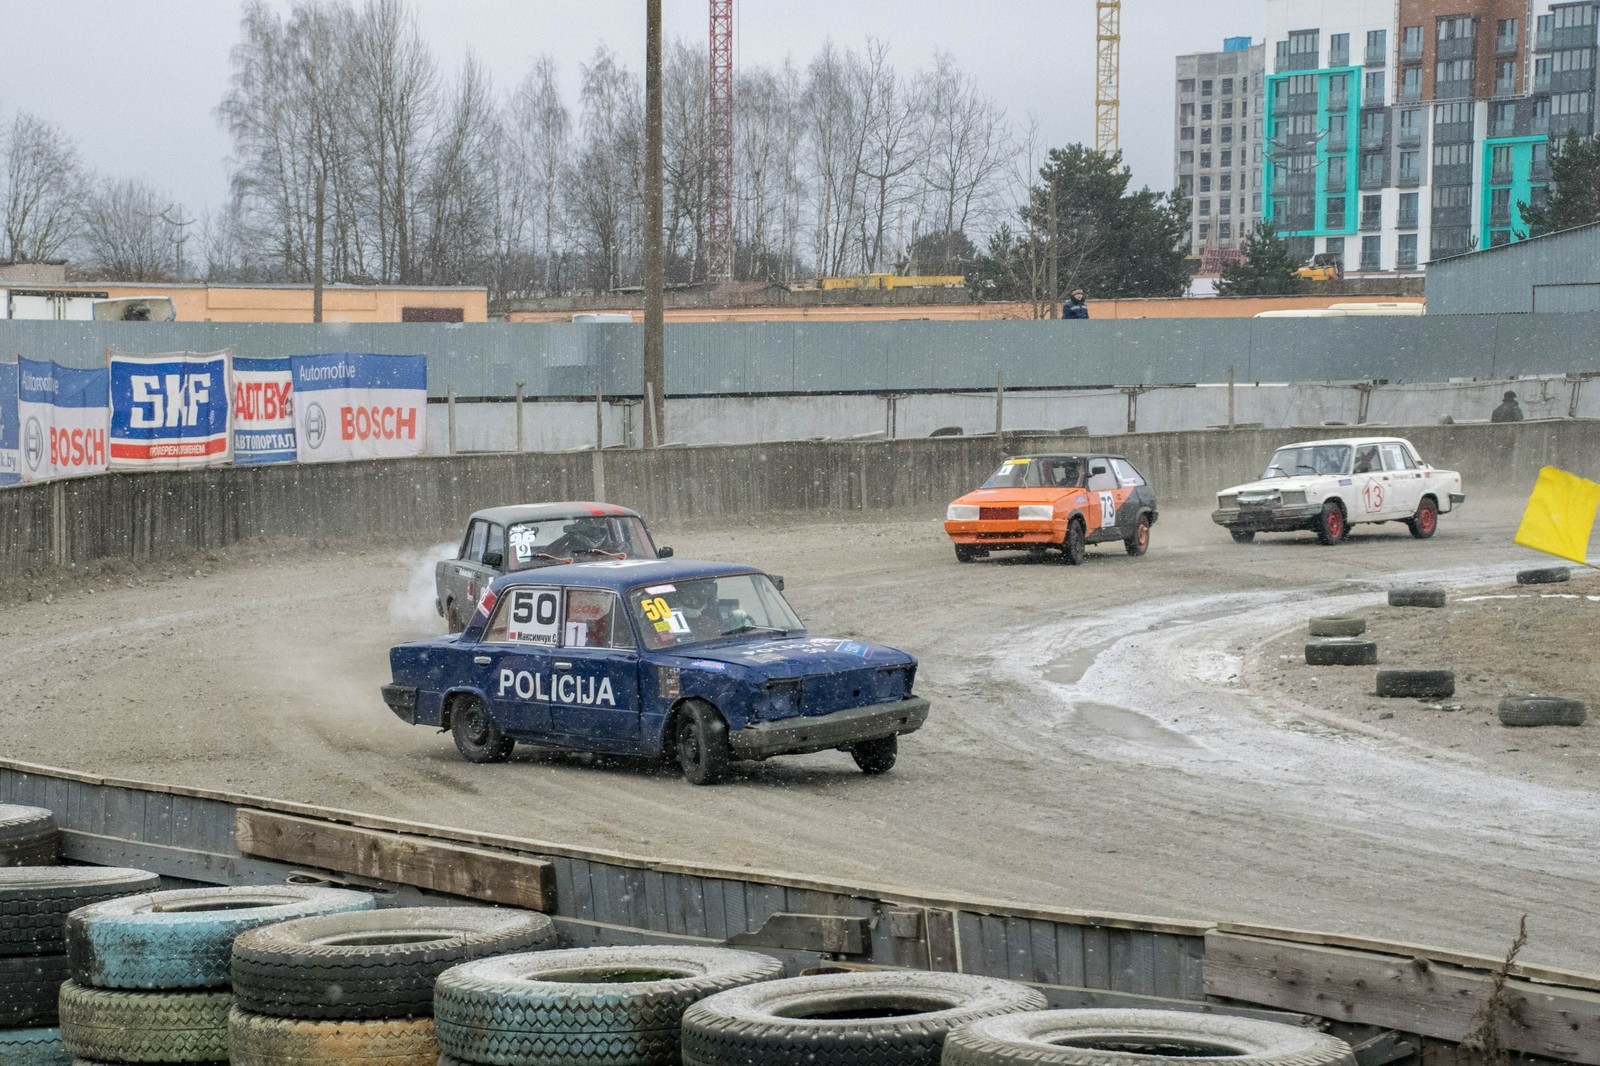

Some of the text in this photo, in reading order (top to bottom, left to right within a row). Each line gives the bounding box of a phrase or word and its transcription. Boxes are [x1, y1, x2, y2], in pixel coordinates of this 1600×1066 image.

[300, 361, 356, 380] Automotive
[130, 373, 211, 428] SKF
[341, 406, 416, 440] BOSCH
[50, 426, 105, 467] BOSCH
[235, 433, 296, 450] АВТОПОРТАЛ
[1101, 495, 1115, 519] 73
[1364, 485, 1382, 508] 13
[519, 544, 528, 555] 9
[513, 592, 557, 625] 50
[641, 597, 673, 620] 50
[673, 613, 686, 630] 1
[517, 631, 551, 644] Максимчук
[572, 625, 579, 646] 1
[497, 668, 616, 706] POLICIJA
